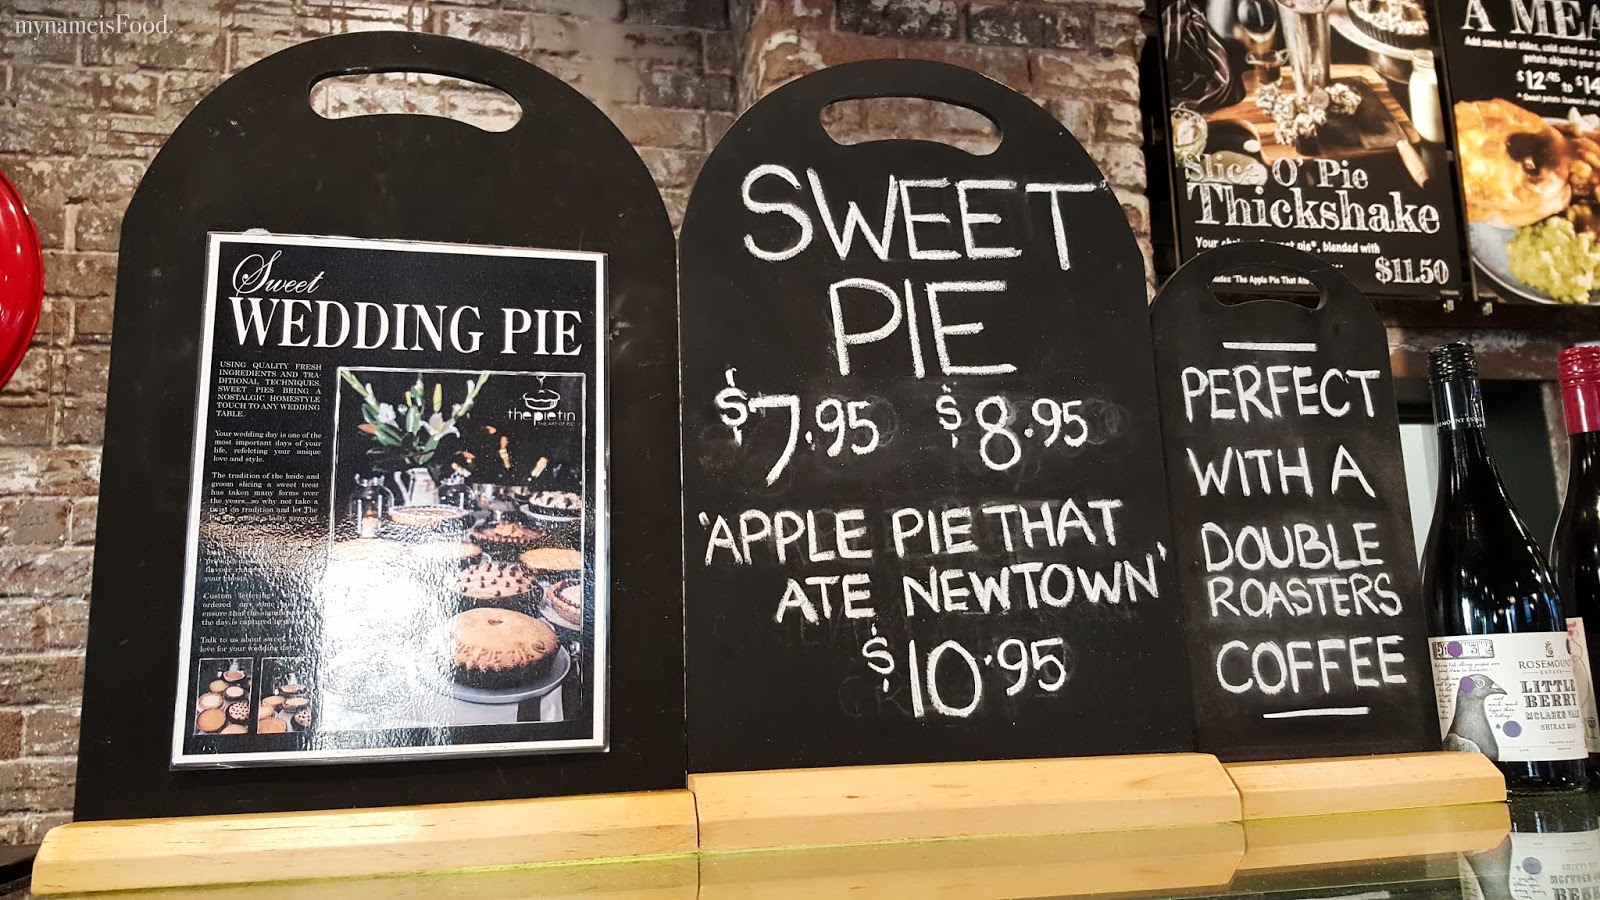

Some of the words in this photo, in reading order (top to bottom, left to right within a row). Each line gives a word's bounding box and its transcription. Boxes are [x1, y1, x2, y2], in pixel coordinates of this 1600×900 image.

[1460, 0, 1497, 32] A
[1464, 35, 1481, 46] Add
[1482, 39, 1503, 48] some
[1504, 38, 1517, 49] hot
[1518, 40, 1541, 52] sides,
[1542, 43, 1558, 53] cold
[1559, 45, 1578, 55] salad
[1523, 54, 1548, 65] potato
[1548, 55, 1569, 67] chips
[1569, 58, 1578, 67] to
[1578, 60, 1595, 69] your
[1523, 92, 1542, 102] Sweet
[1542, 95, 1561, 103] potato
[1561, 82, 1574, 93] to
[1184, 152, 1261, 183] Slice
[1315, 158, 1369, 190] Pie
[741, 164, 1098, 270] SWEET
[1186, 182, 1441, 234] Thickshake
[1196, 236, 1217, 248] Your
[1322, 242, 1359, 253] blended
[1360, 243, 1381, 254] with
[232, 250, 325, 296] Sweet
[1250, 276, 1268, 285] Apple
[1268, 276, 1280, 284] Pie
[1282, 276, 1297, 285] That
[1374, 255, 1449, 285] $11.50
[229, 296, 484, 354] WEDDING
[501, 308, 583, 356] PIE
[829, 278, 1017, 379] PIE
[218, 377, 259, 385] DITIONAL
[219, 369, 277, 377] INGREDIENTS
[252, 362, 289, 370] QUALITY
[1181, 364, 1381, 423] PERFECT
[216, 410, 245, 418] TABLE.
[234, 430, 264, 439] wedding
[265, 431, 278, 439] day
[236, 439, 272, 447] important
[1186, 446, 1314, 498] WITH
[1331, 444, 1376, 498] A
[262, 498, 278, 506] why
[892, 506, 979, 558] PIE
[982, 498, 1123, 552] THAT
[1201, 522, 1384, 573] DOUBLE
[775, 573, 877, 625] ATE
[1207, 572, 1403, 619] ROASTERS
[1216, 634, 1407, 695] COFFEE
